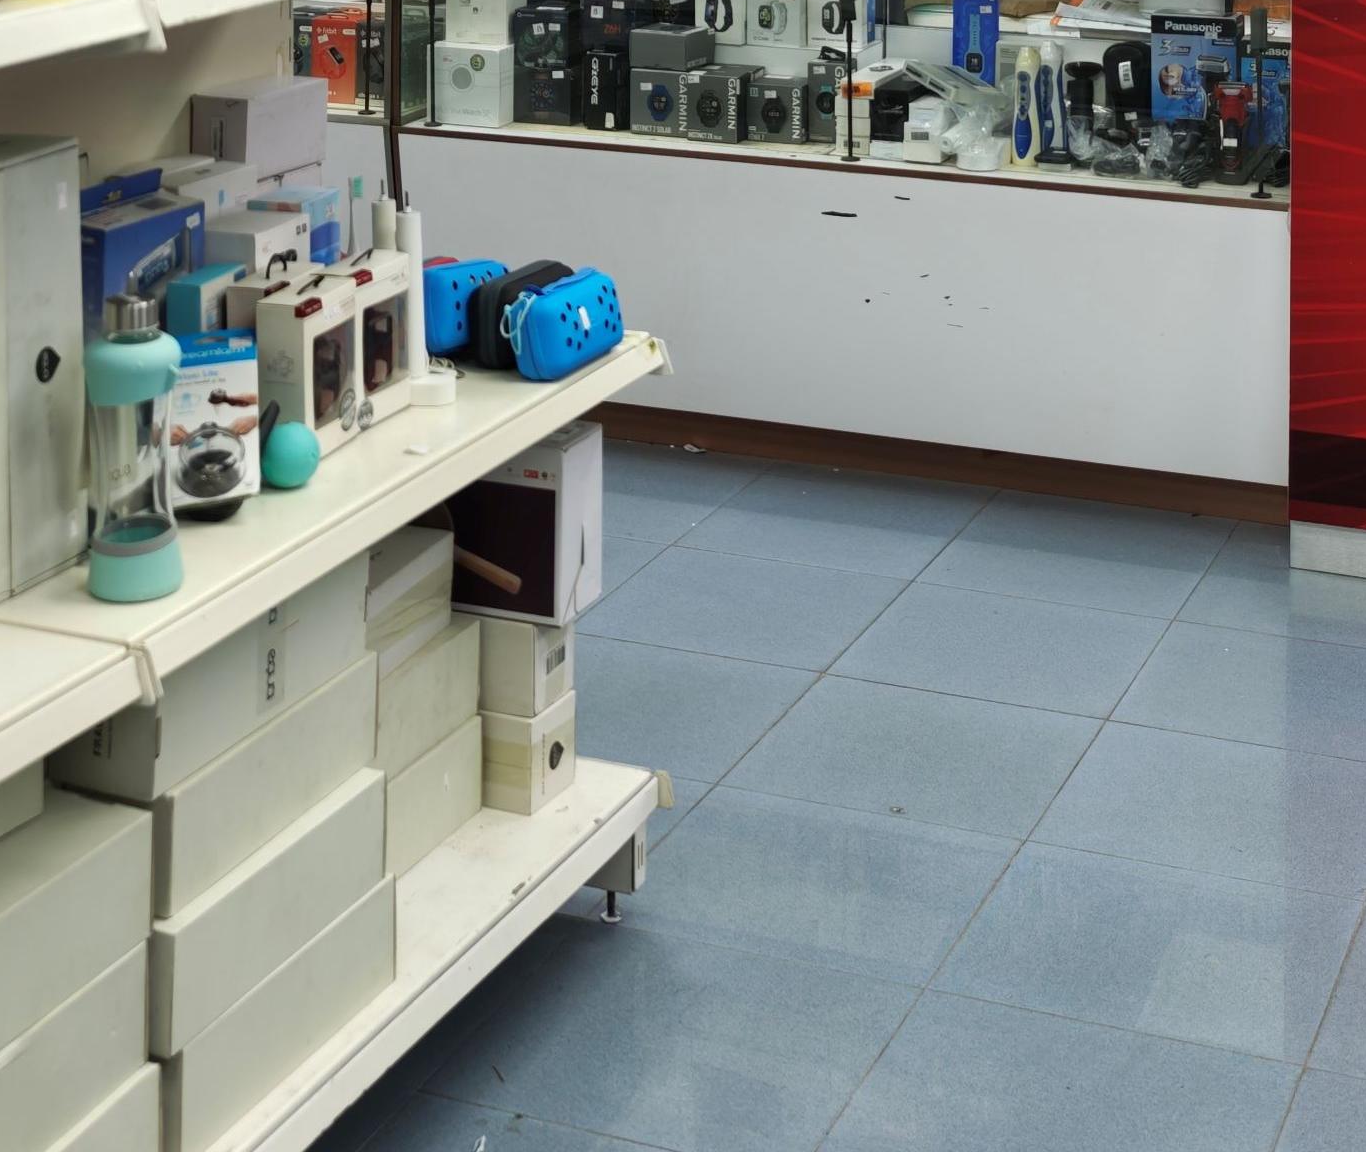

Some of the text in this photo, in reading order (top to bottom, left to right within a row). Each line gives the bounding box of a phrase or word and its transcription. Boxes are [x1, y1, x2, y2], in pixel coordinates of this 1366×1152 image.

[1165, 20, 1222, 33] Panasonic
[679, 75, 687, 131] GARMIN
[728, 78, 736, 130] GARMIN
[791, 88, 801, 139] GARMIN
